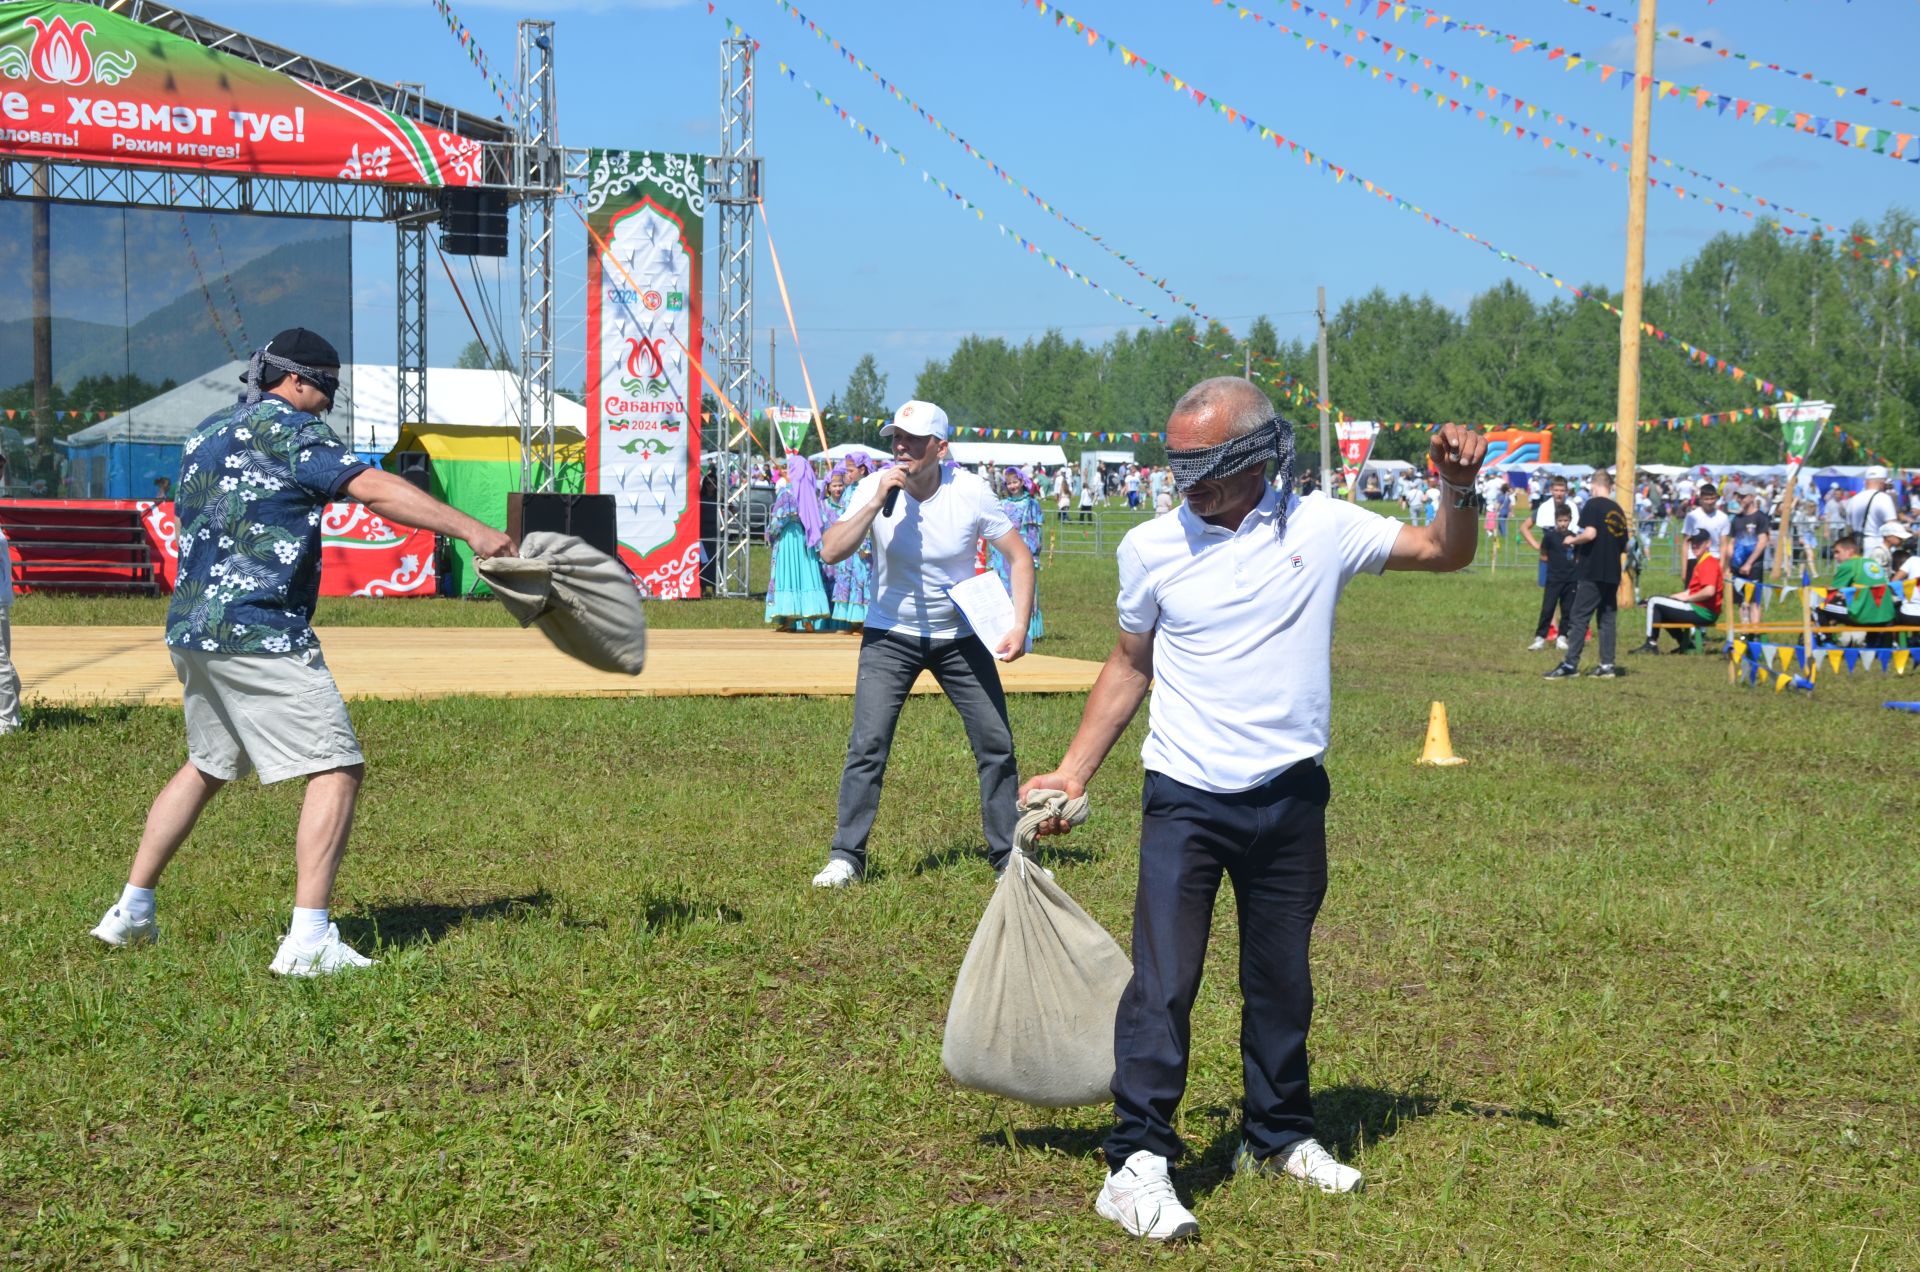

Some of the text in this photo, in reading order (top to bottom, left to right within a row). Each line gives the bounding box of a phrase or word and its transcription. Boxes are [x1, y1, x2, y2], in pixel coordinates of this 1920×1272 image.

[0, 91, 29, 120] е
[66, 97, 217, 136] хезмәт
[229, 106, 305, 142] туе!
[112, 133, 241, 159] Рәхим итегез!
[632, 420, 657, 431] 2024
